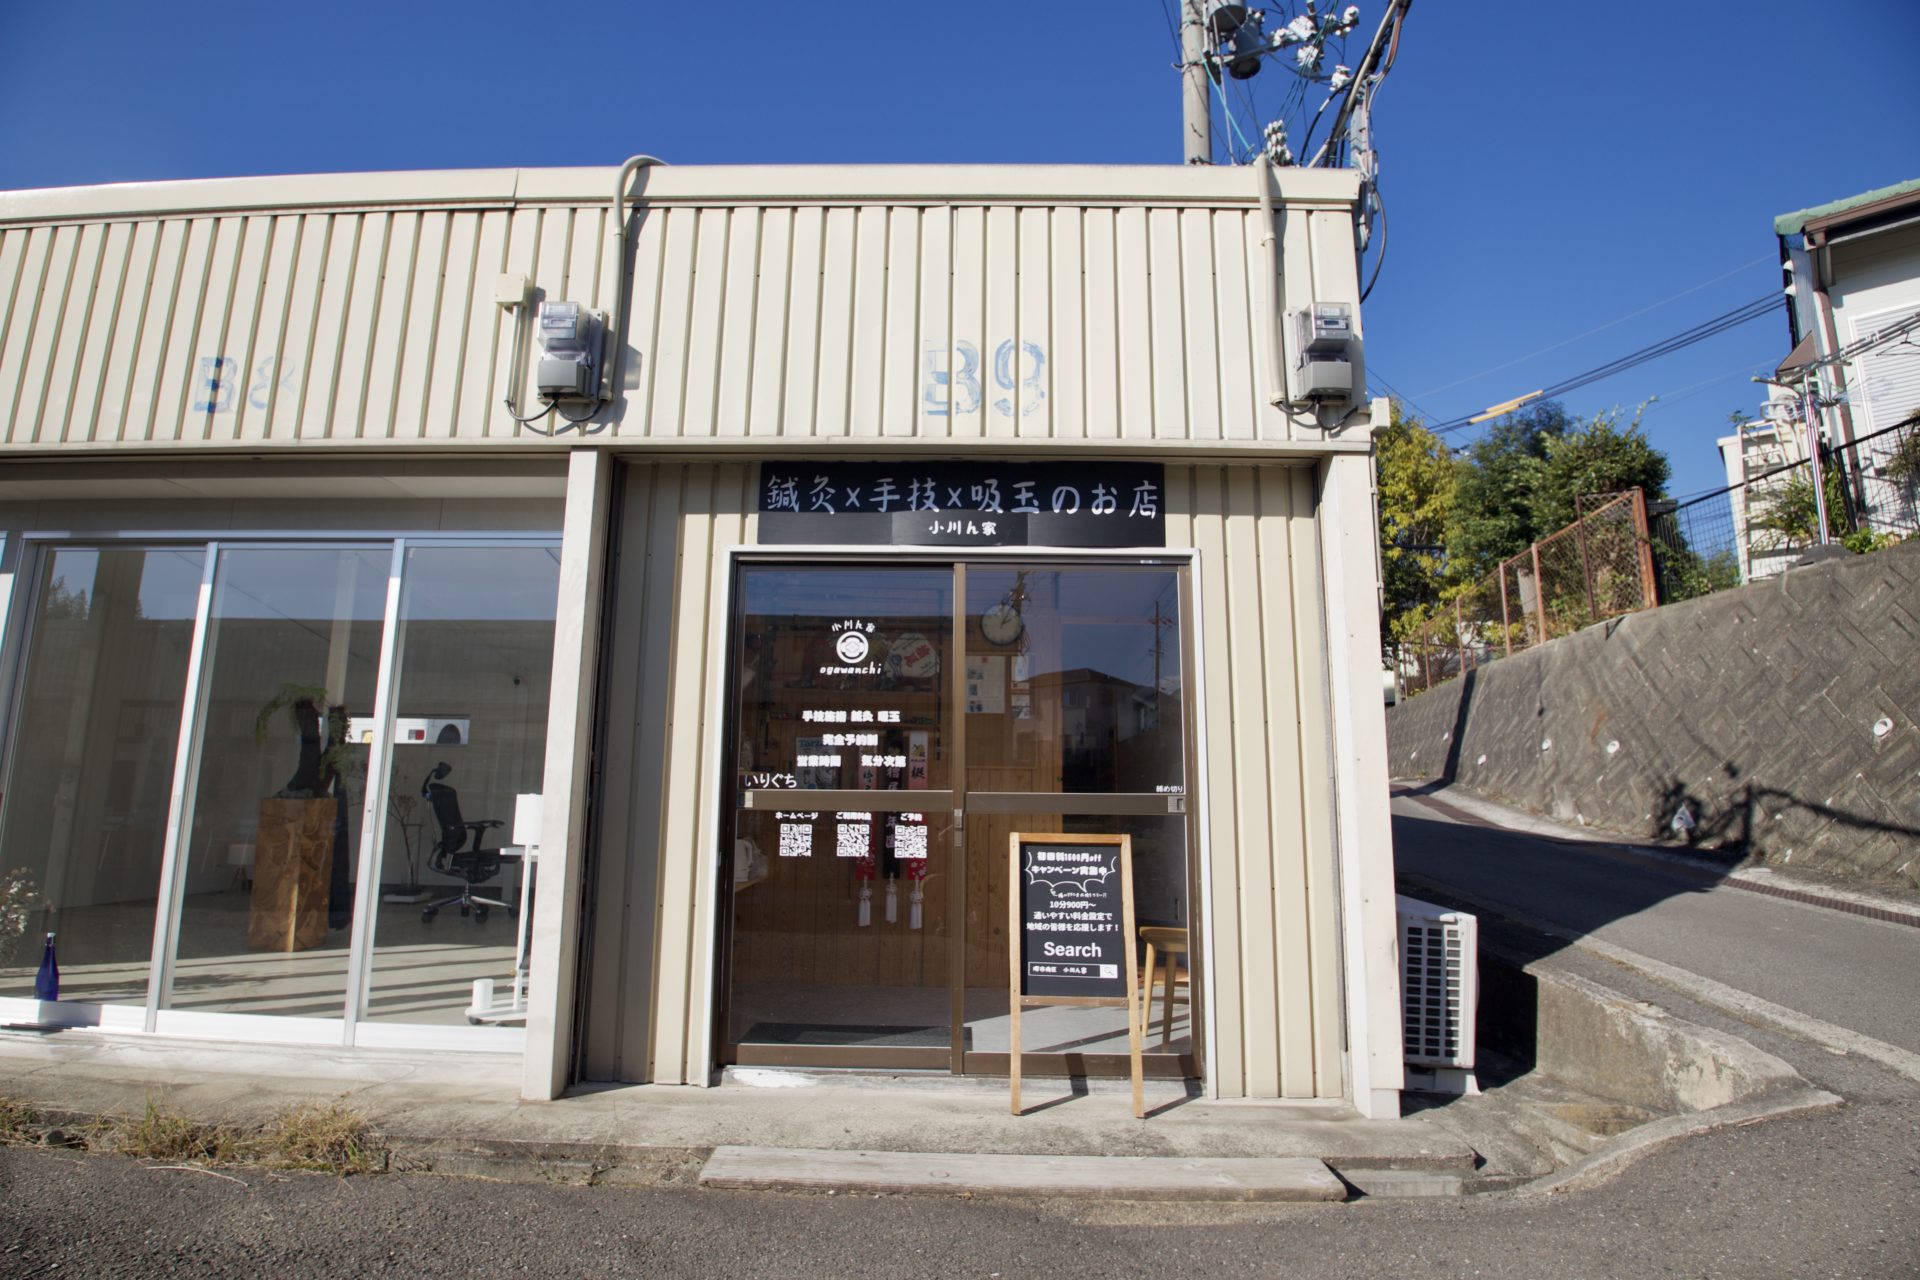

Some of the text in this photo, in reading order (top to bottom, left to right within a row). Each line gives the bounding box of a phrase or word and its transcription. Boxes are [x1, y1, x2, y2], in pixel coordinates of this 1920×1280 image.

[928, 520, 997, 536] 小川ん家
[819, 661, 882, 675] ogawanchi
[745, 772, 798, 789] いりぐち
[775, 811, 819, 820] ホームページ
[1043, 941, 1102, 958] Search
